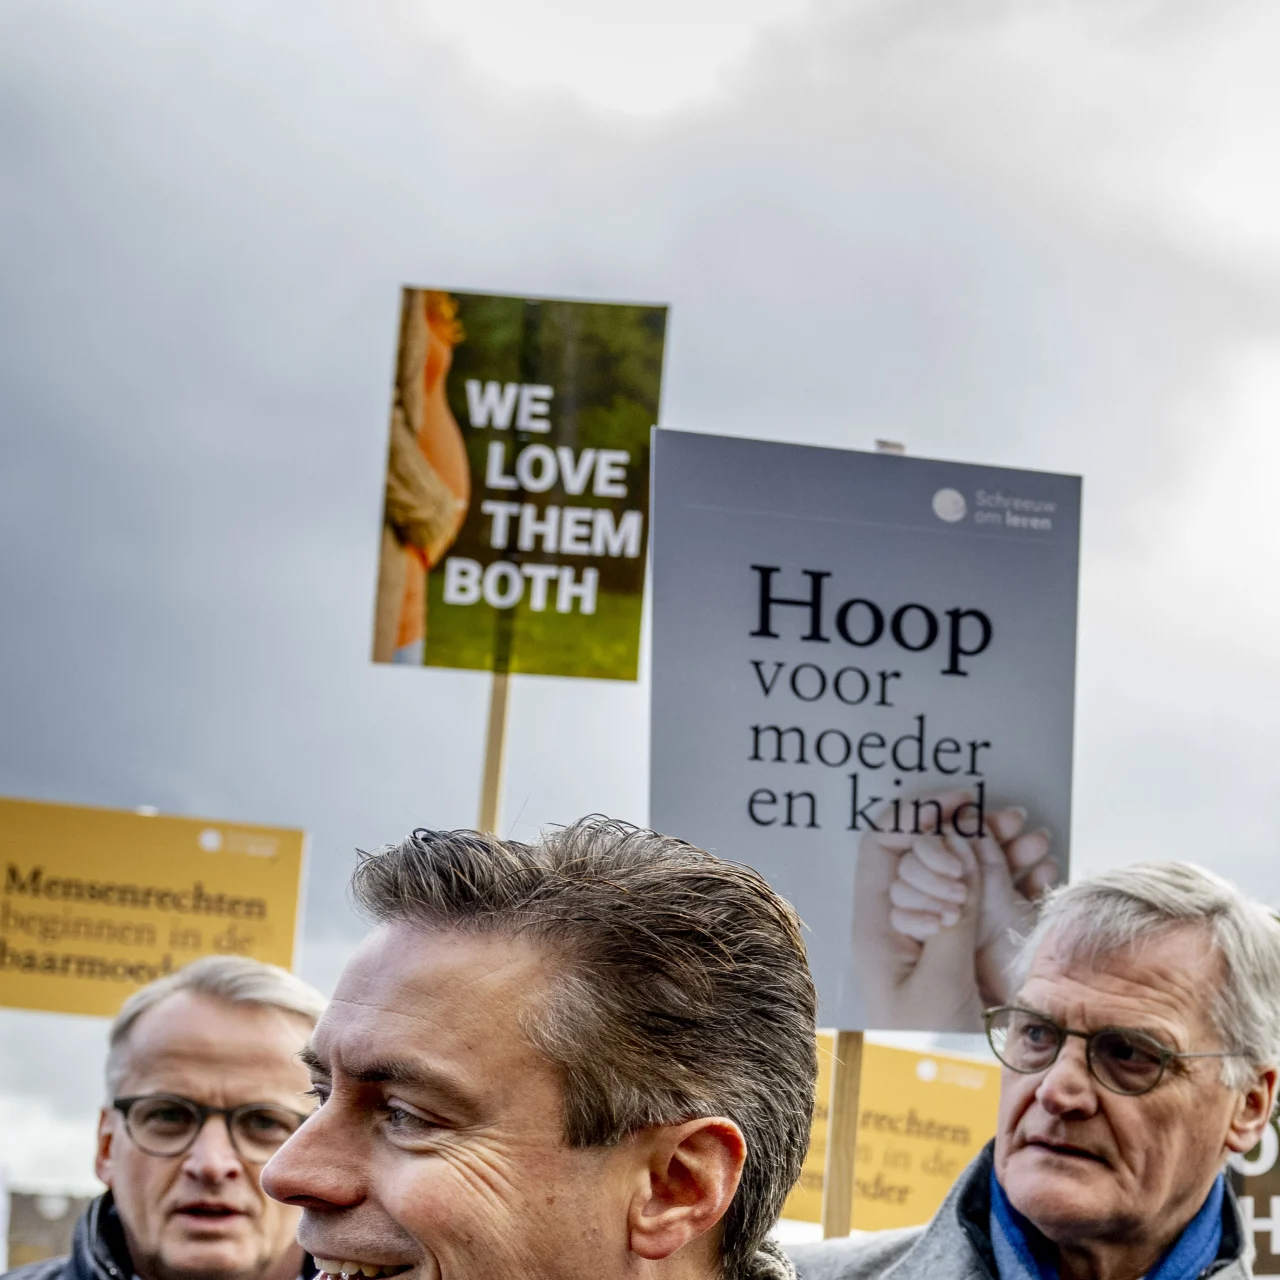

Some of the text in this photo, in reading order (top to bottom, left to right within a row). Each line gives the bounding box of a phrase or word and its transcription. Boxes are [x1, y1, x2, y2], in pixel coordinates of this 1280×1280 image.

[465, 380, 553, 433] WE
[484, 441, 630, 498] LOVE
[482, 500, 643, 560] THEM
[1005, 509, 1052, 531] leven
[443, 557, 599, 615] BOTH
[750, 565, 993, 678] Hoop
[750, 658, 901, 707] voor
[748, 713, 992, 777] moeder
[748, 774, 988, 839] en kind
[4, 861, 268, 920] Mensenrechten
[0, 902, 257, 953] beginnen in de
